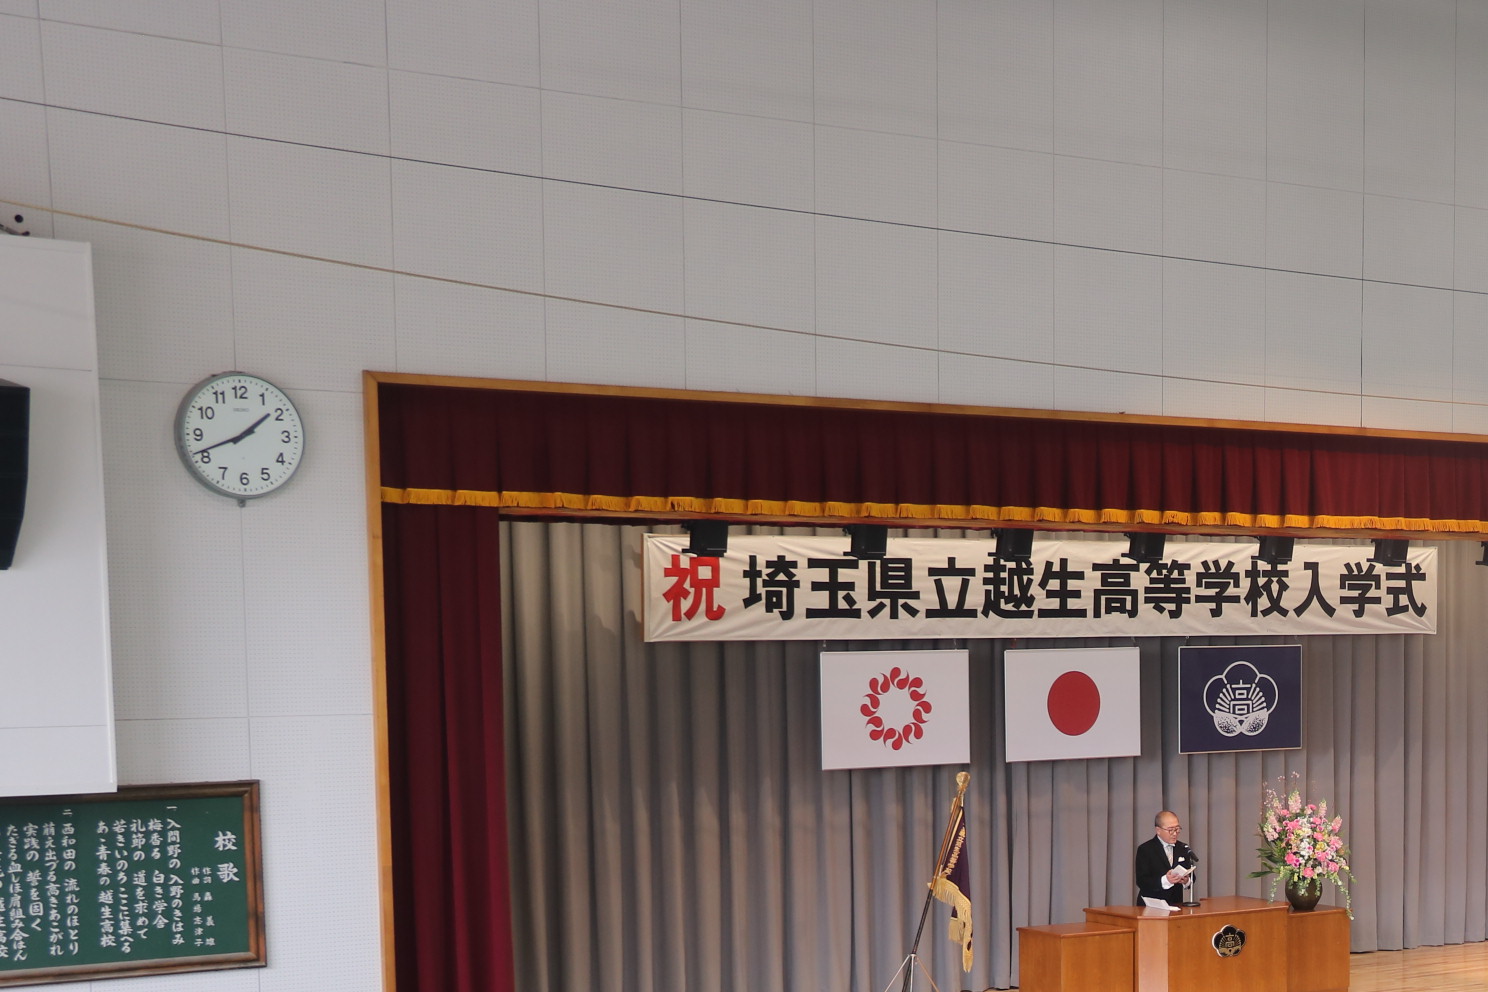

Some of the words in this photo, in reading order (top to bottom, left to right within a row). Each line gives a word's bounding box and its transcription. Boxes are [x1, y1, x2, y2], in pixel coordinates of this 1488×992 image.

[212, 390, 226, 404] 11
[231, 385, 249, 400] 12
[259, 392, 266, 406] 1
[197, 405, 215, 420] 10
[274, 407, 285, 421] 2
[193, 427, 204, 442] 9
[281, 430, 291, 444] 3
[200, 450, 212, 465] 8
[275, 452, 286, 466] 4
[218, 466, 229, 480] 7
[239, 472, 250, 486] 6
[260, 467, 271, 481] 5
[662, 554, 726, 622] 祝
[742, 554, 1428, 621] 埼玉県立越生高等学校入学式
[213, 830, 240, 884] 校歌
